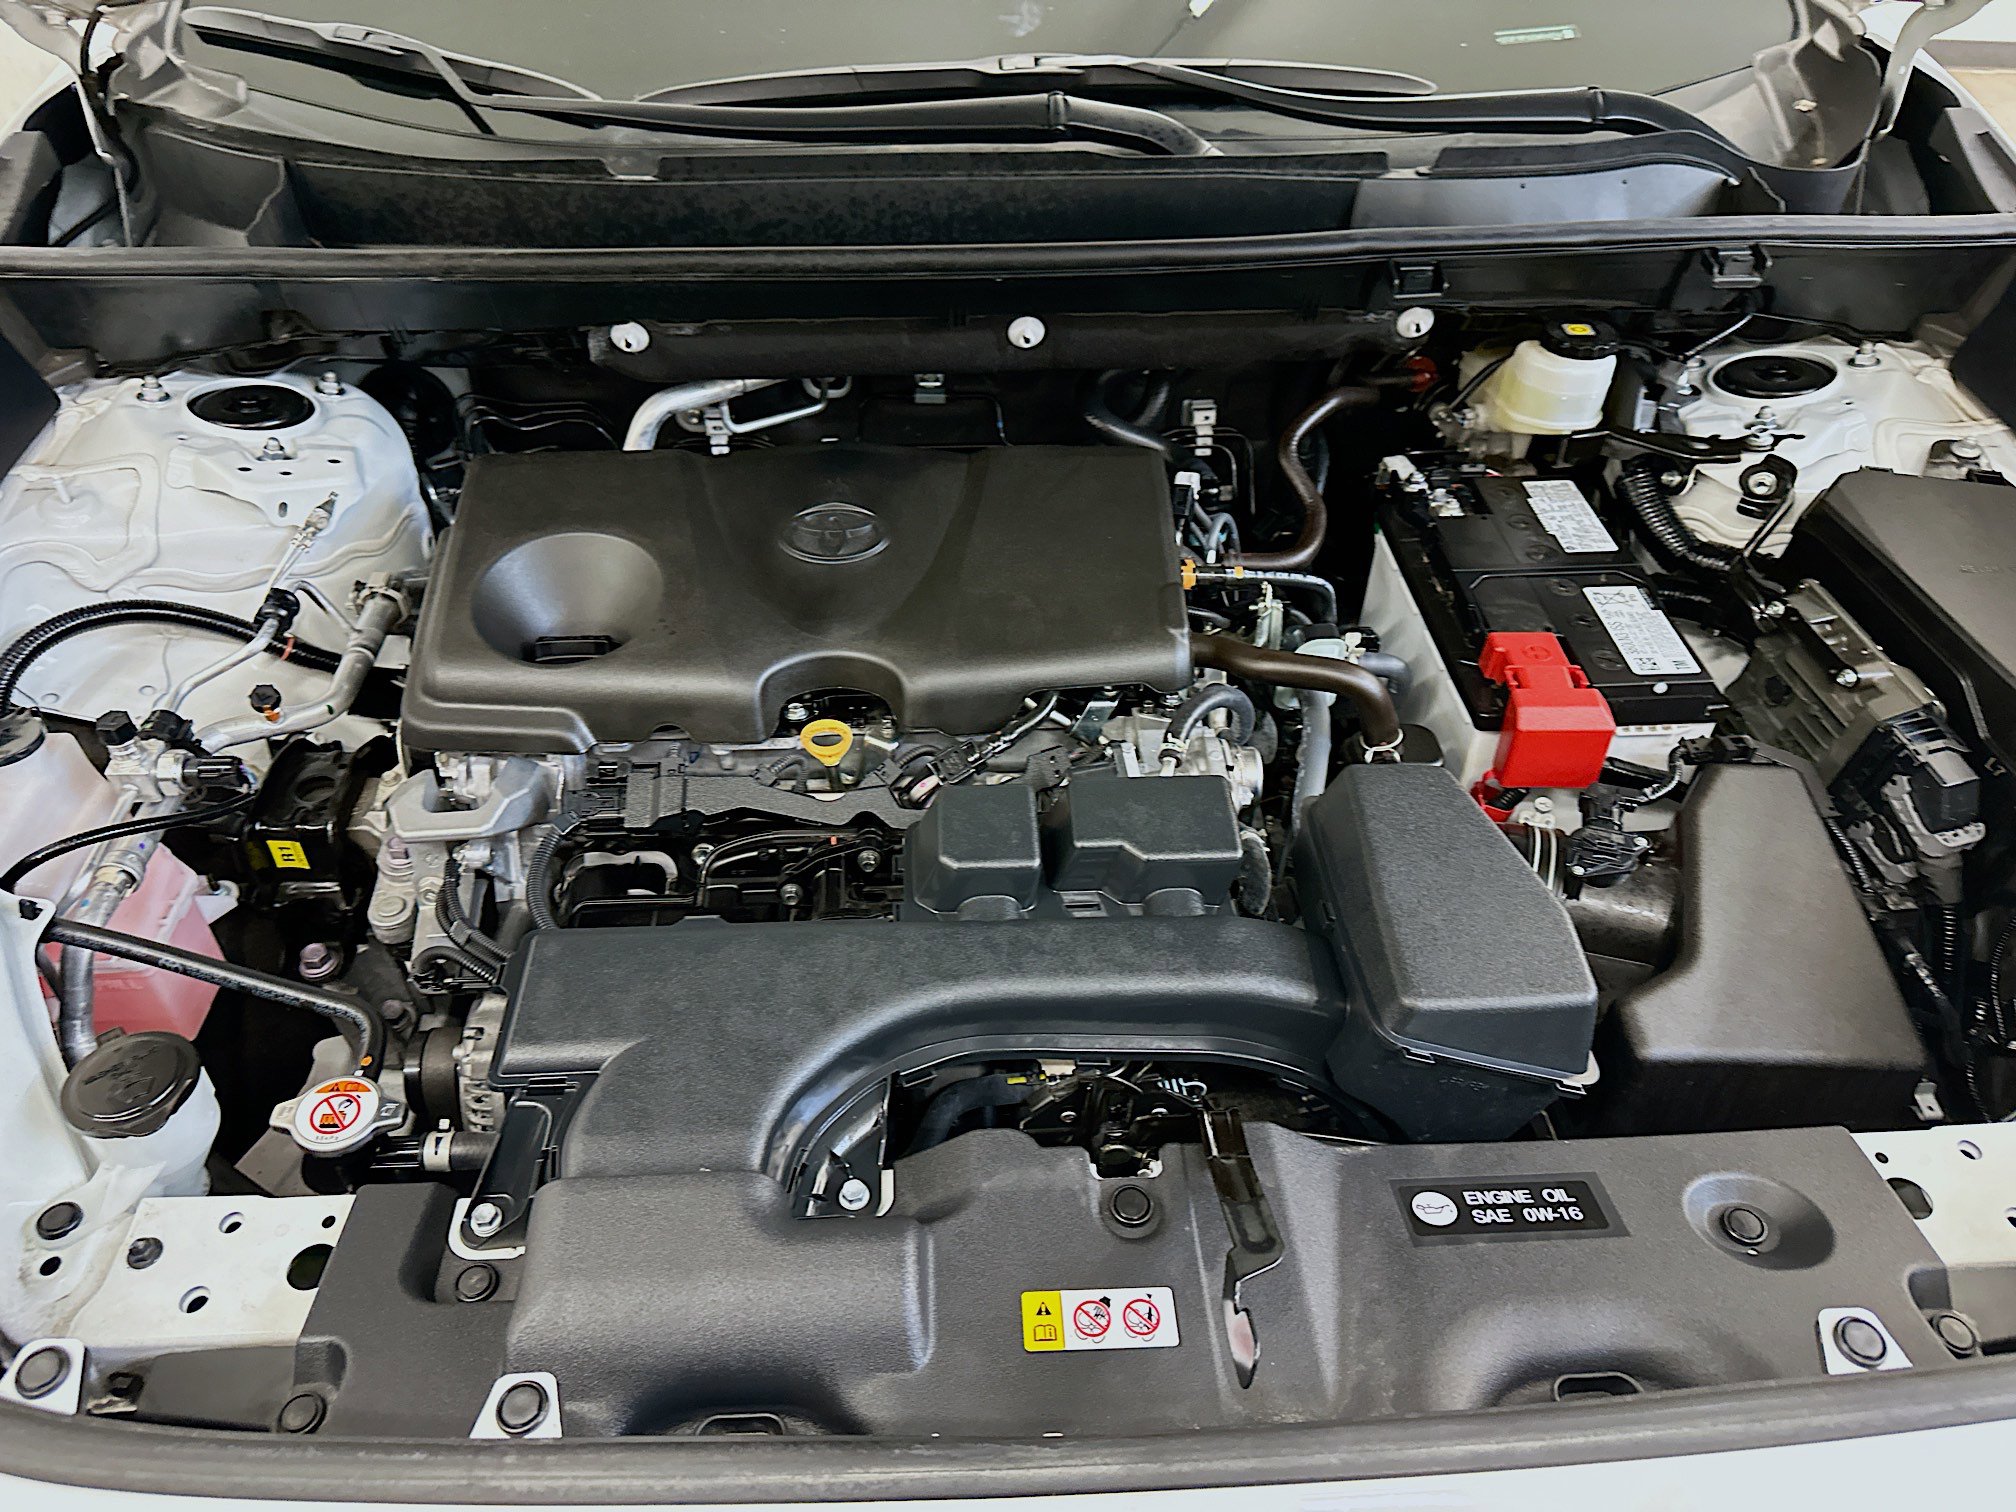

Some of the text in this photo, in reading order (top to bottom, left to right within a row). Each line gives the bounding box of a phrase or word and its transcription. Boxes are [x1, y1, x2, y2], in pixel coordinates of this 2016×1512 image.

[278, 846, 295, 862] R1
[1462, 1188, 1577, 1205] ENGINE OIL
[1471, 1206, 1584, 1224] SAE 0W-16
